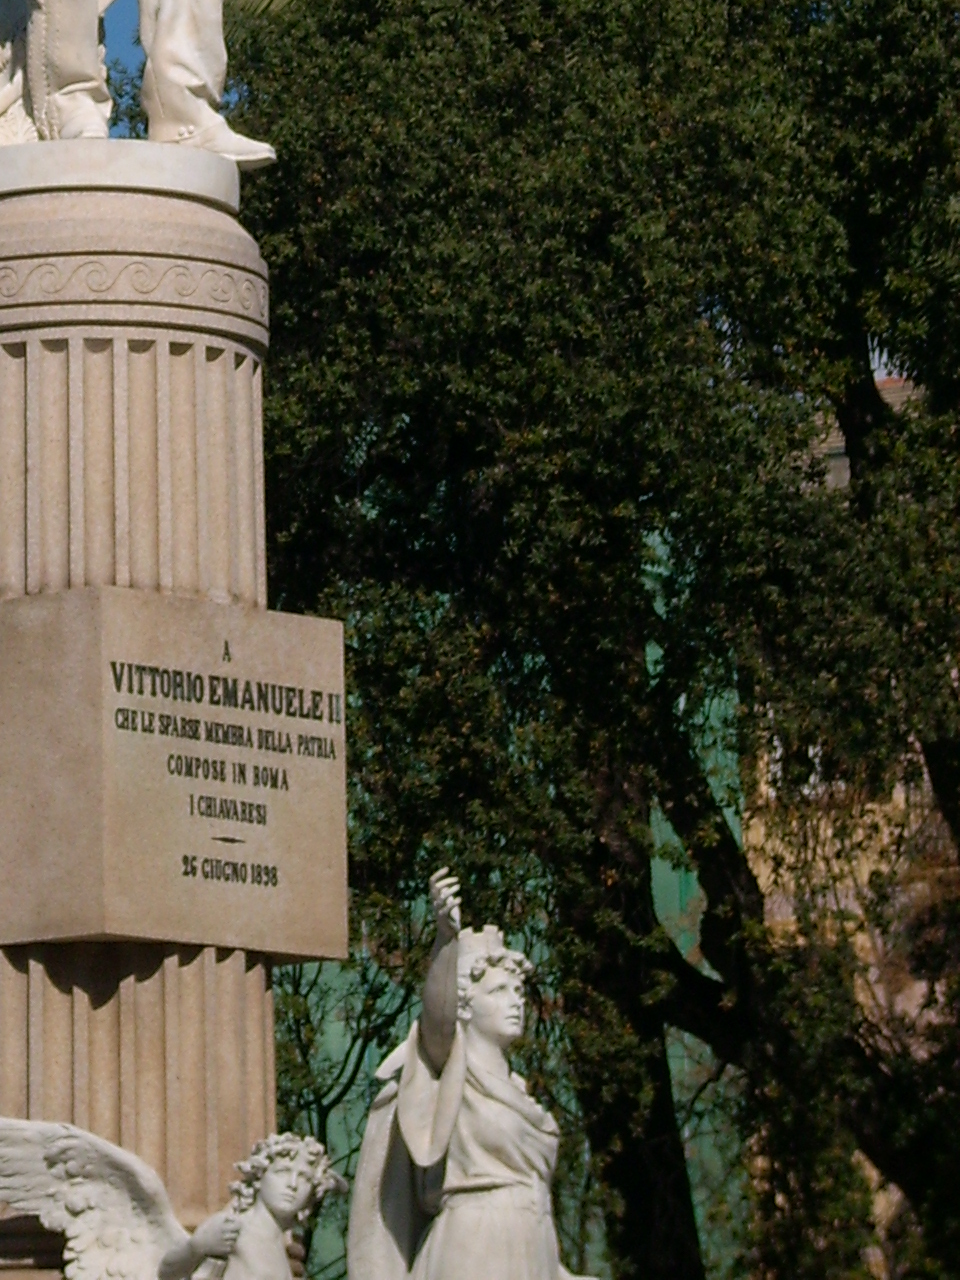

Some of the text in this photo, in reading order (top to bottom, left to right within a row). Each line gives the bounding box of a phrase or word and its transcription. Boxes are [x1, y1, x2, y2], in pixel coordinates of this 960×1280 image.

[222, 640, 231, 662] A
[110, 661, 341, 724] VITTORIO EMANUELE II
[115, 708, 336, 760] CHE LE SPARSE MEMBRA DELLA PATRIA
[167, 754, 289, 791] COMPOSE IN ROMA
[190, 794, 267, 826] I CHIAVARESI
[182, 855, 278, 886] 26 GIUGNO 1898
